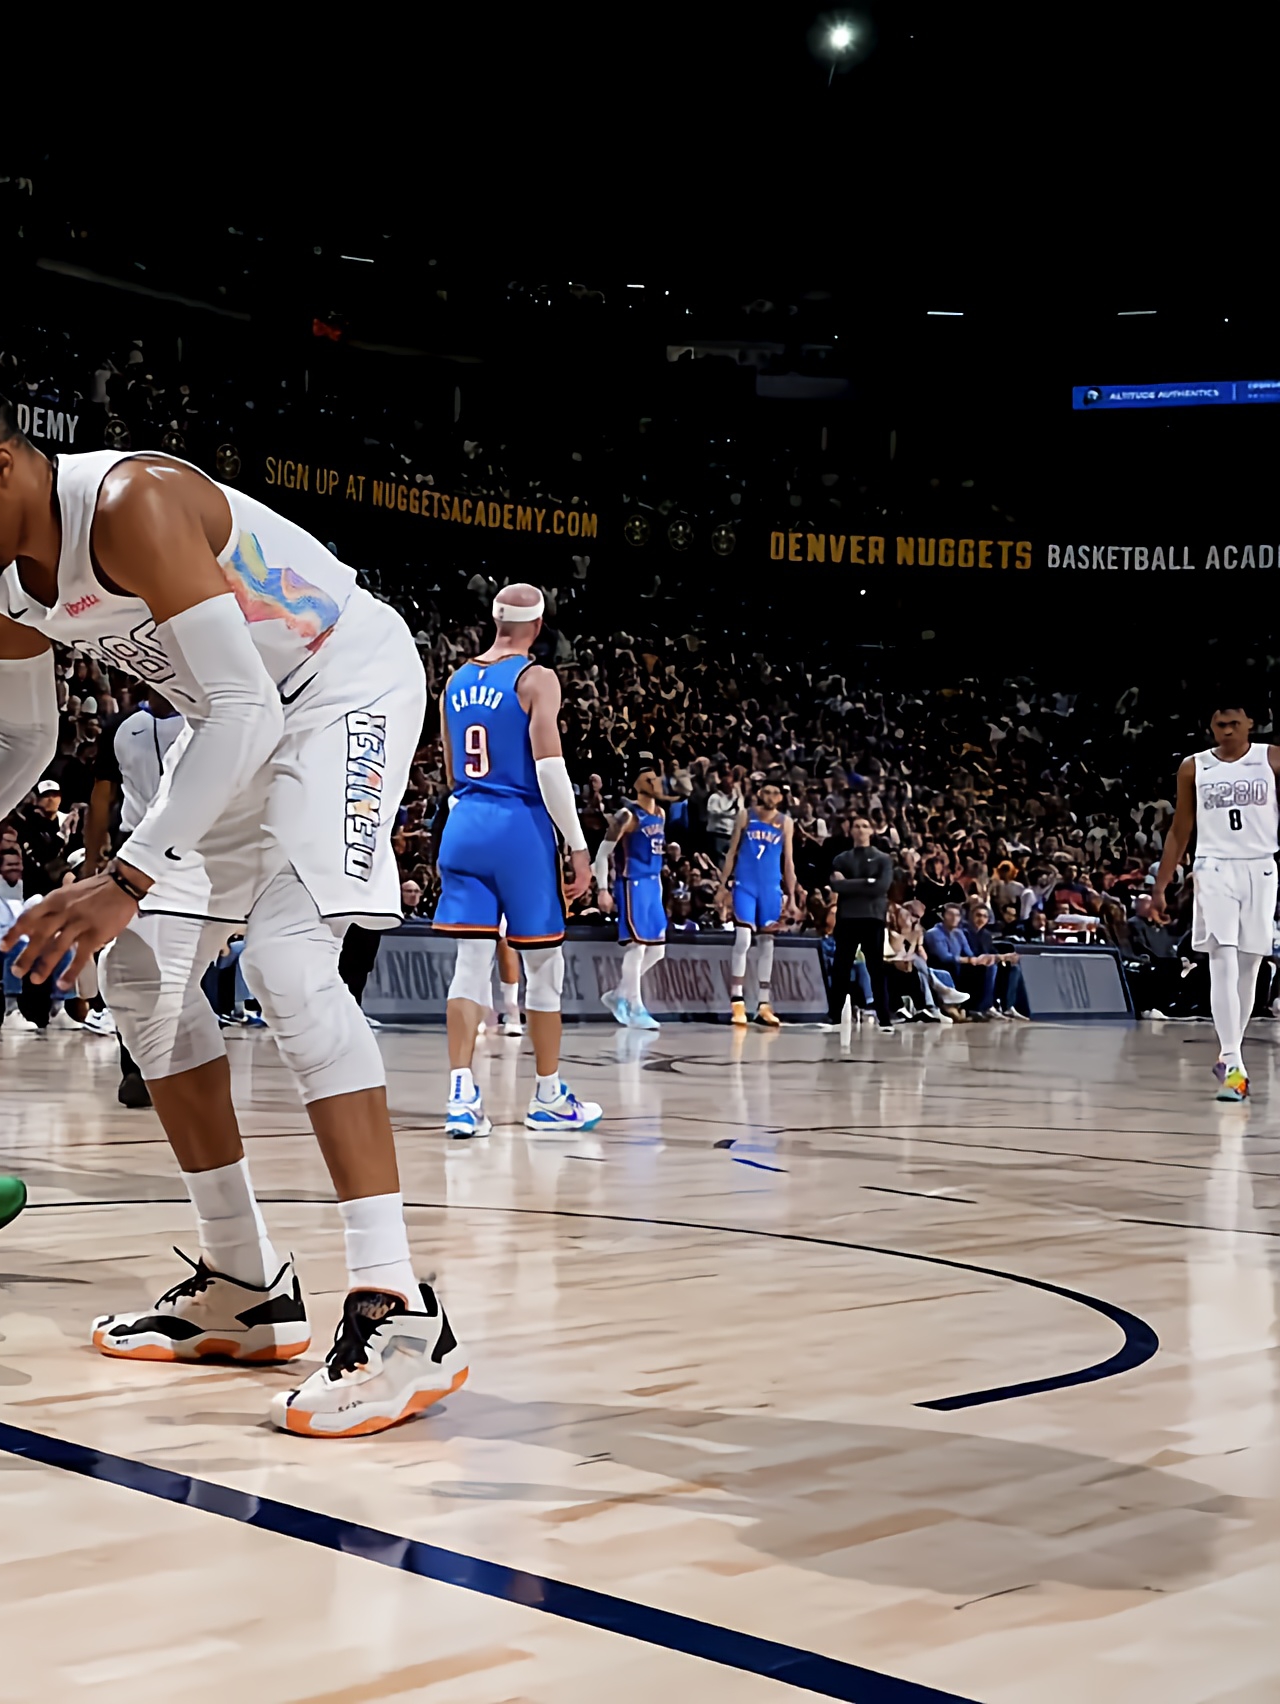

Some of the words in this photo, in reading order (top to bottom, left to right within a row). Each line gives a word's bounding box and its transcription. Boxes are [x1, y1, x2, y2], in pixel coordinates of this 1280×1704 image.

[265, 456, 309, 491] SIGN
[316, 468, 339, 496] UP
[346, 475, 366, 502] AT
[372, 480, 598, 539] NUGGETSACADEMY.COM
[770, 531, 885, 565] DENVER
[896, 536, 1033, 570] NUGGETS
[1047, 544, 1196, 571] BASKETBALL
[1205, 544, 1280, 570] ACAD
[464, 724, 490, 778] 9
[344, 710, 387, 882] DENVER
[1199, 778, 1268, 810] 5280
[1228, 808, 1243, 831] 8
[756, 844, 766, 860] 7
